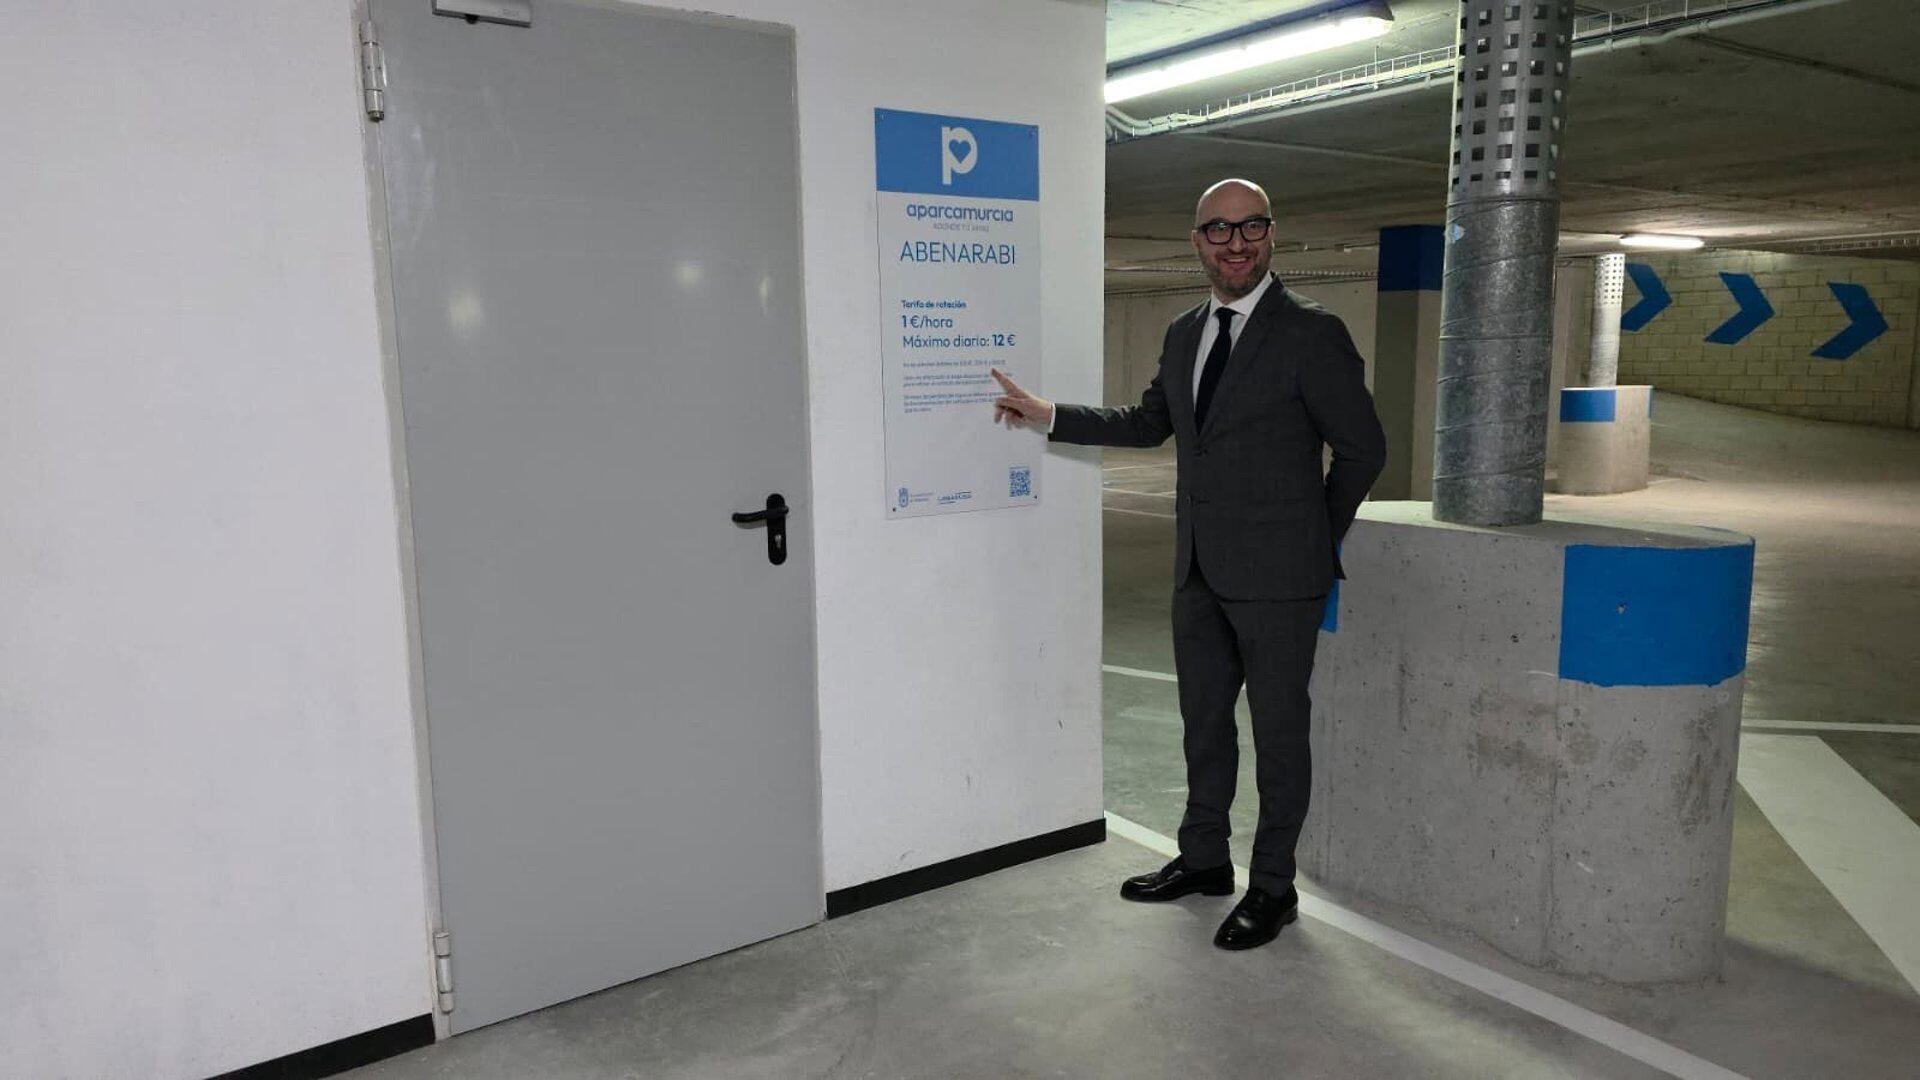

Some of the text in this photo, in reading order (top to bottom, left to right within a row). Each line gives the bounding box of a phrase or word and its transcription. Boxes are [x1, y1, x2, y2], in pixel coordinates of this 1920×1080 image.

[906, 203, 1014, 222] aparcamurcia
[900, 241, 1015, 264] ABENARABI
[901, 300, 924, 309] Tarifa
[925, 300, 934, 308] de
[902, 315, 953, 328] 1 €/hora
[903, 334, 1016, 348] Máximo diario: 12 €
